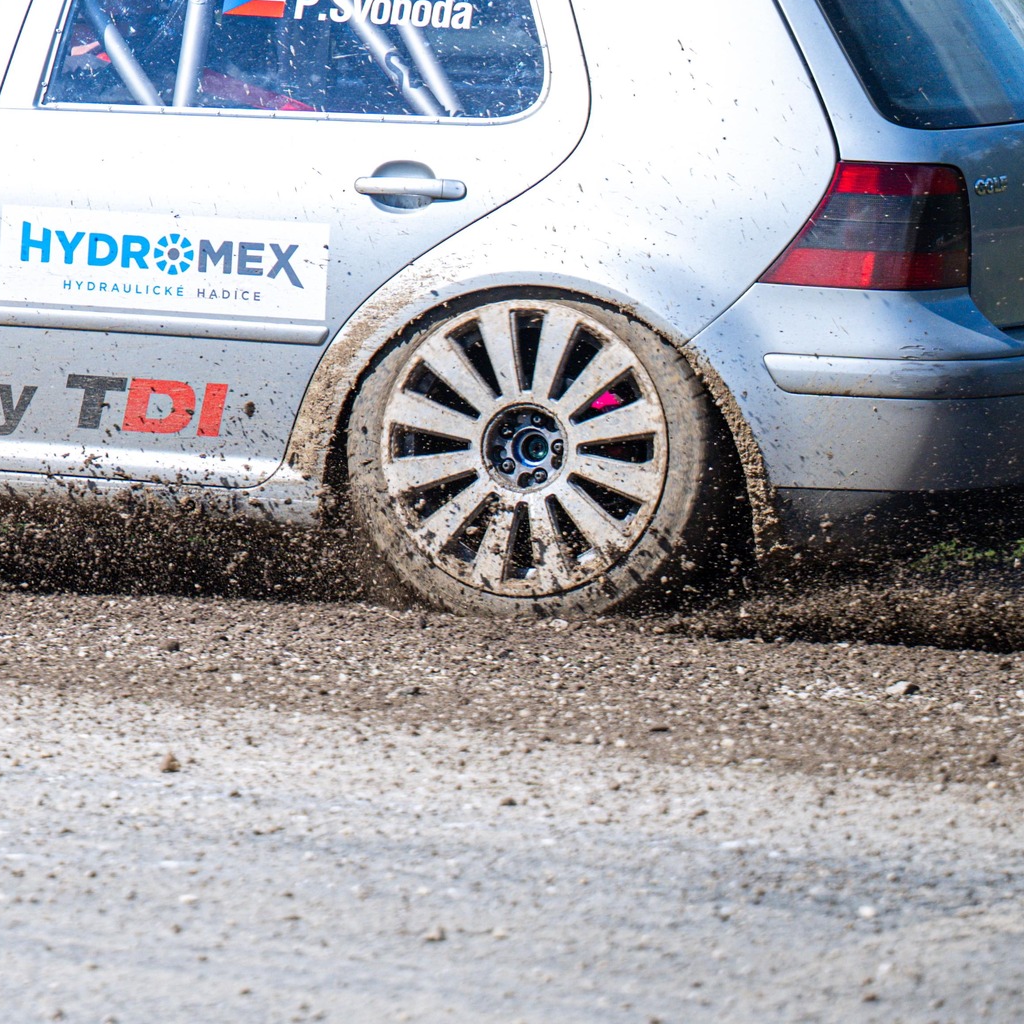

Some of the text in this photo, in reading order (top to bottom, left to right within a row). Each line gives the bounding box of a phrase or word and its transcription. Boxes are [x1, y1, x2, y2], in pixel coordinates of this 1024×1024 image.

[974, 175, 1008, 196] GOLF
[20, 221, 304, 290] HYDROMEX
[63, 279, 262, 302] HYDRAULICKÉ HADICE
[66, 374, 228, 437] TDI
